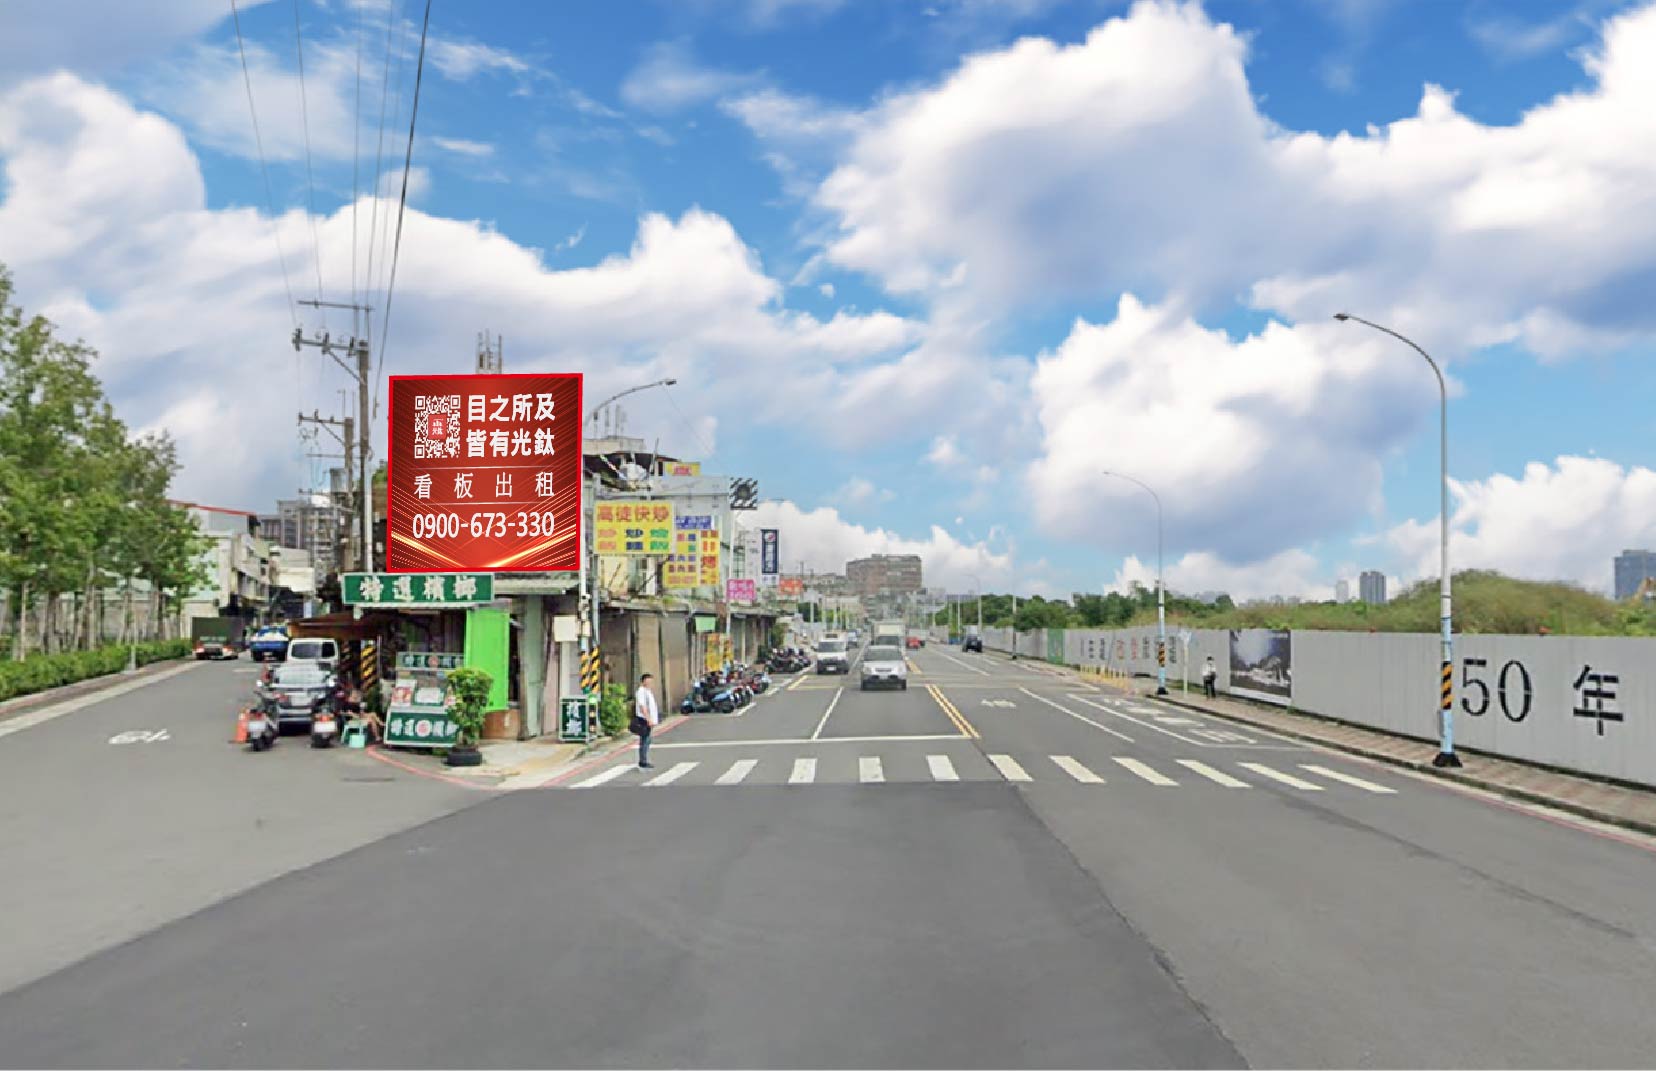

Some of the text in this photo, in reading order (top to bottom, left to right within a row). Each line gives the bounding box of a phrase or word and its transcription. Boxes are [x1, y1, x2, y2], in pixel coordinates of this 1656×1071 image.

[468, 393, 555, 421] 目之所及
[466, 429, 555, 458] 皆有光鈦
[414, 471, 555, 500] 看板出租
[412, 511, 555, 539] 0900-673-330
[1461, 657, 1533, 722] 50
[1572, 664, 1624, 736] 年
